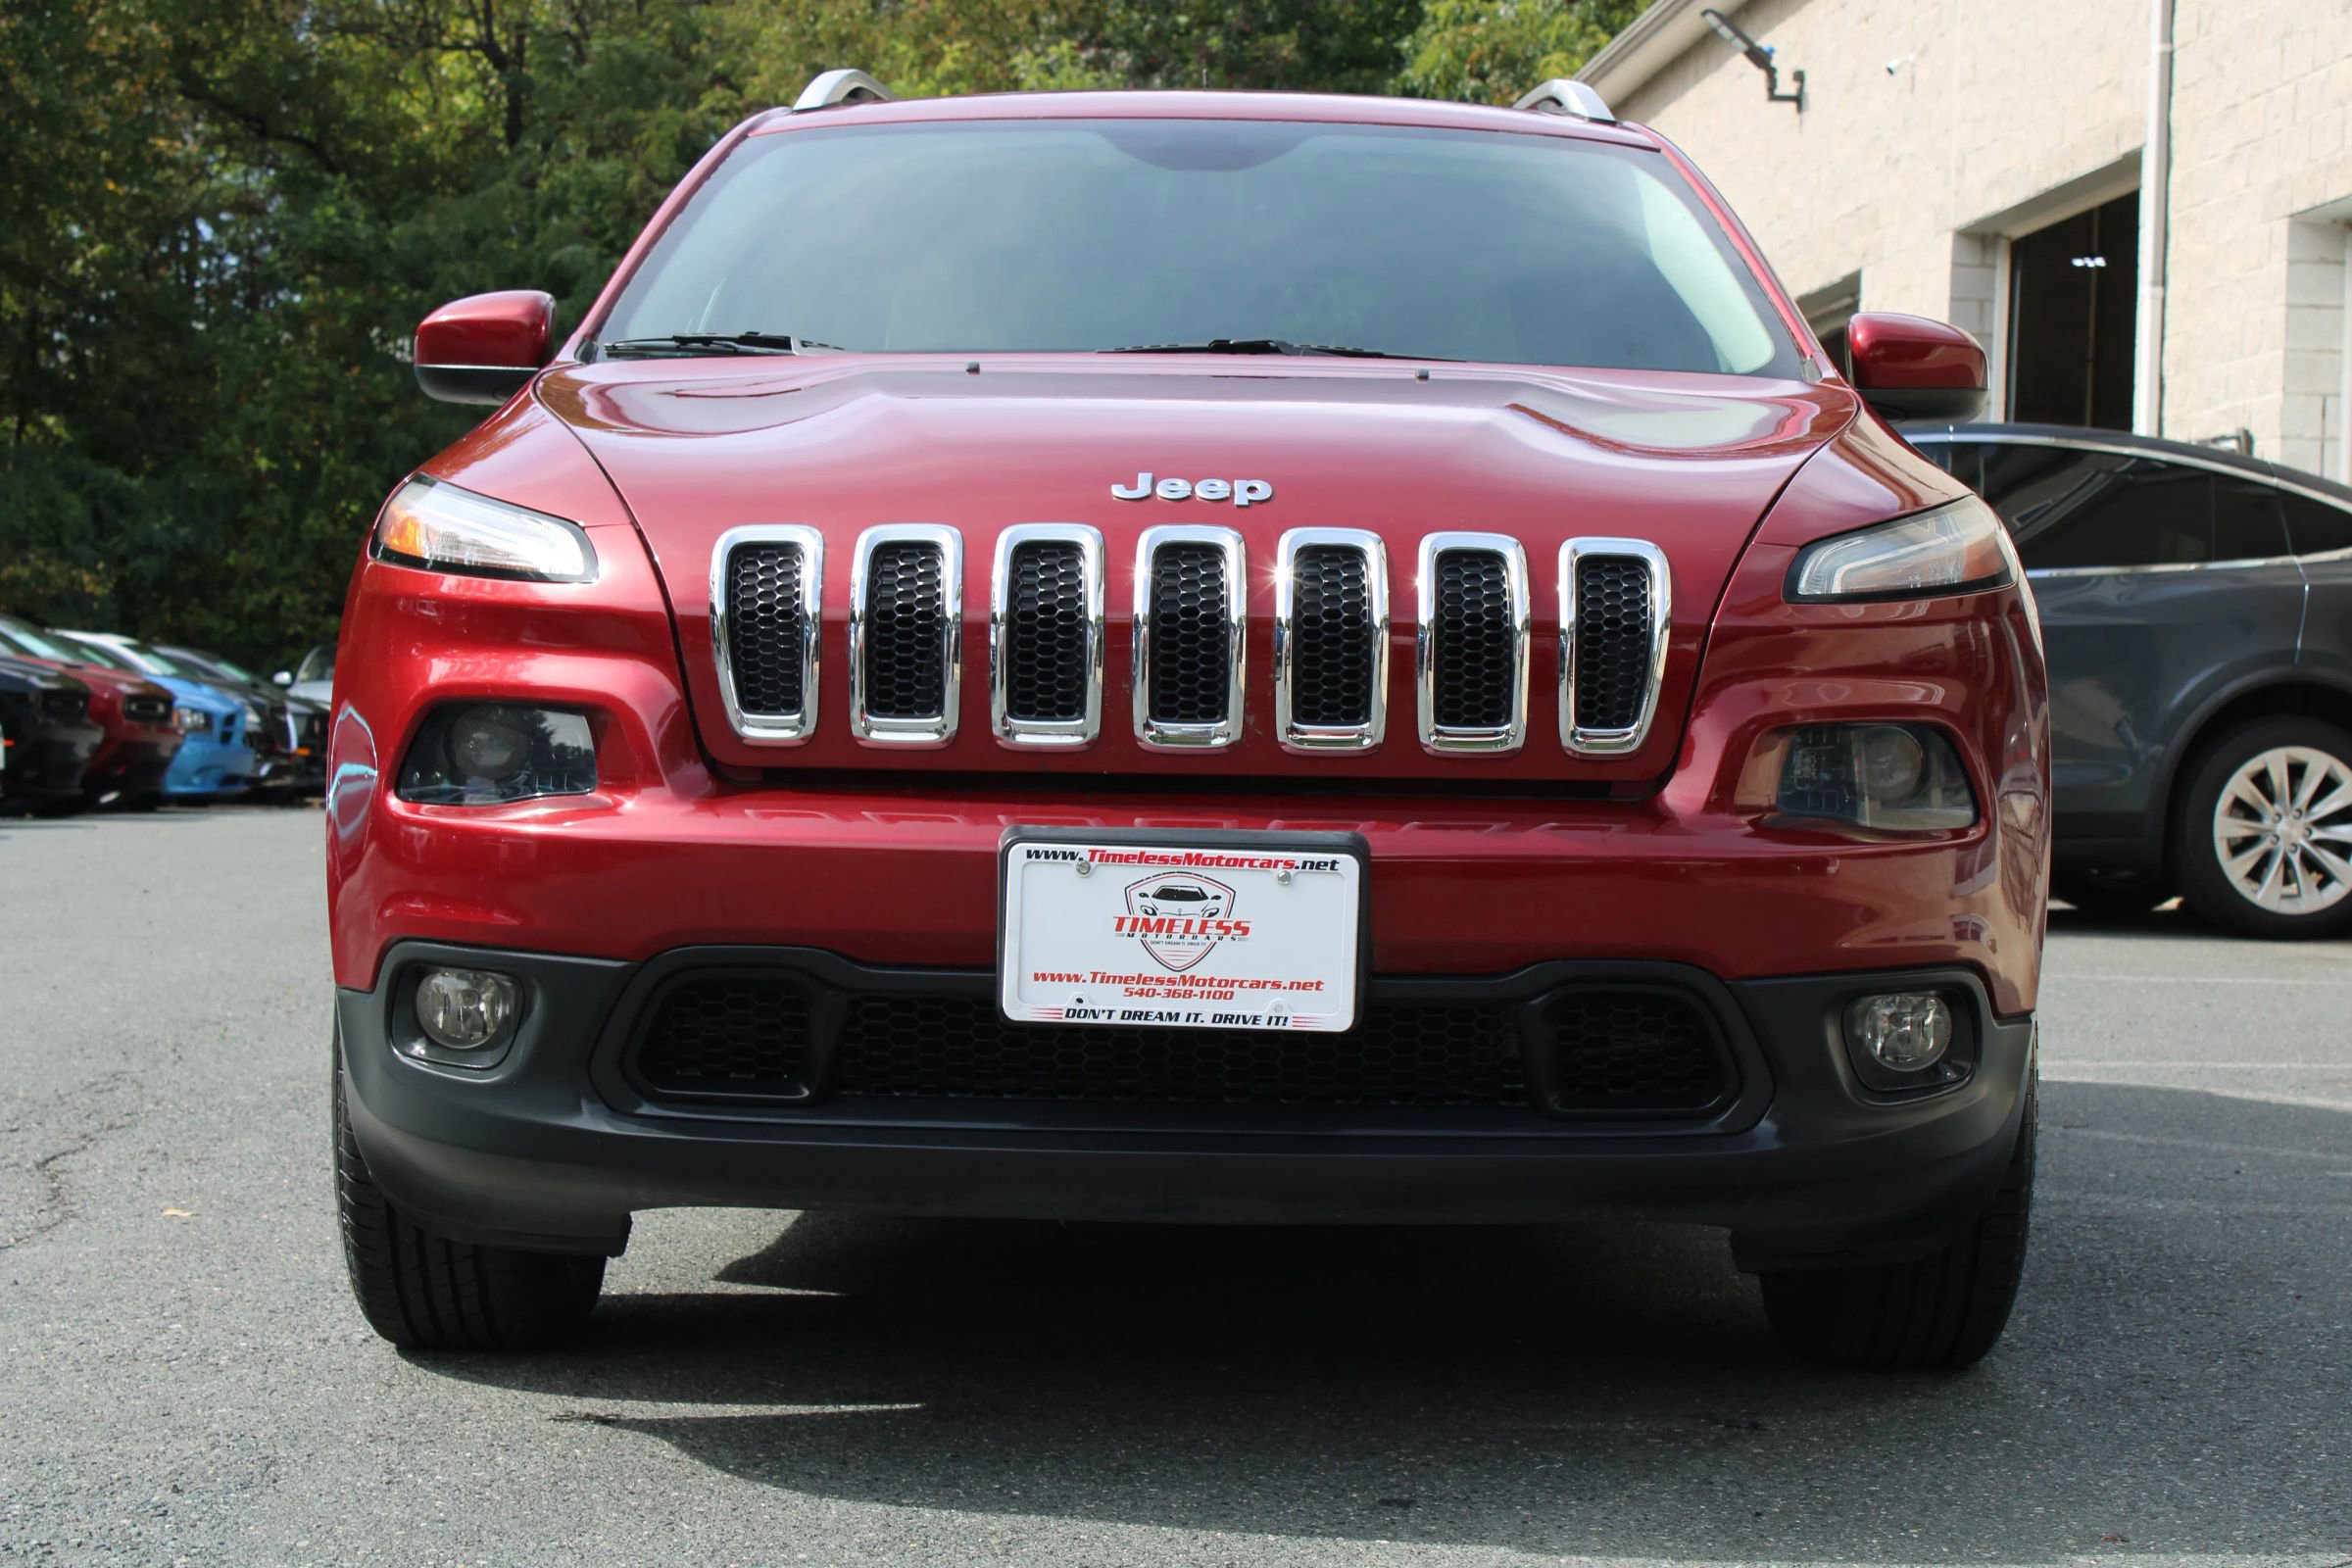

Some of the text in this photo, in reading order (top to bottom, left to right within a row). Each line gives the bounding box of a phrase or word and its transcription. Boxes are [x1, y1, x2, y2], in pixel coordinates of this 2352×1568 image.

[1111, 472, 1273, 506] Jeep
[1026, 849, 1340, 871] www.TimelessMotorcars.net
[1113, 916, 1252, 936] TIMELESS
[1126, 932, 1236, 941] MOTORCARS
[1034, 971, 1325, 992] www.TimelessMotorcars.net
[1123, 988, 1235, 1002] 540-368-1100
[1065, 1007, 1289, 1026] DON'T DREAM IT. DRIVE IT!
